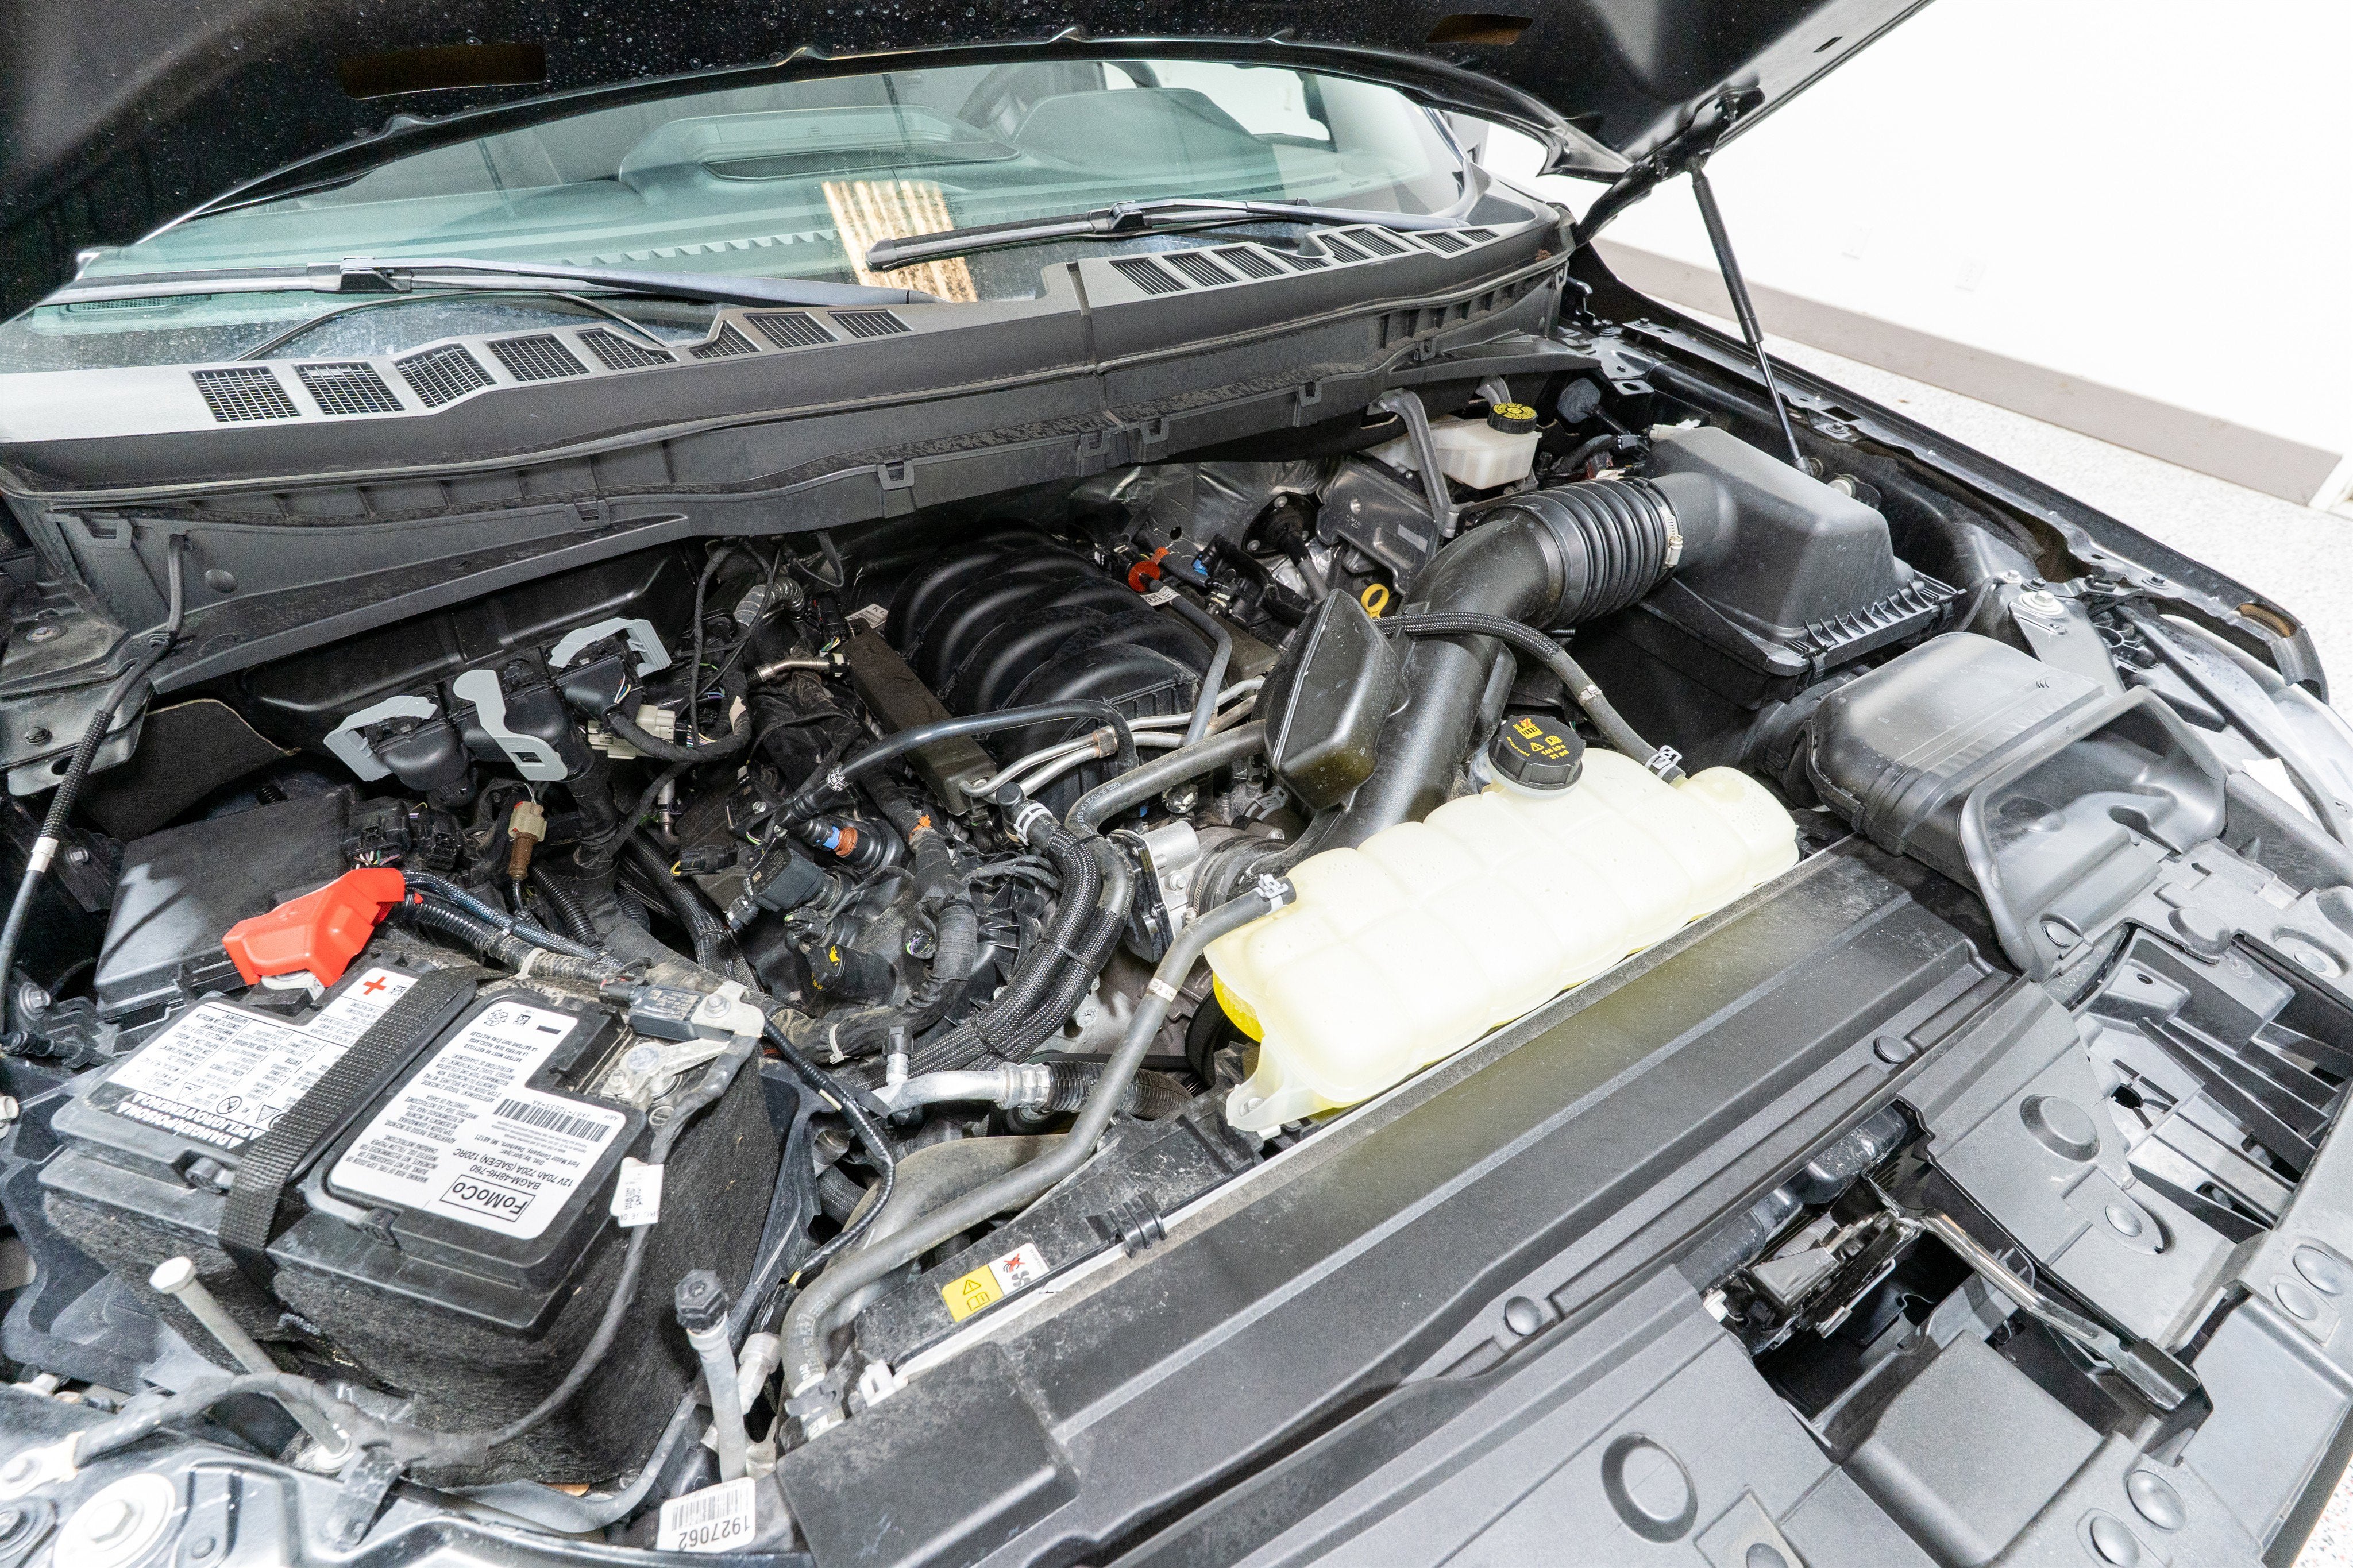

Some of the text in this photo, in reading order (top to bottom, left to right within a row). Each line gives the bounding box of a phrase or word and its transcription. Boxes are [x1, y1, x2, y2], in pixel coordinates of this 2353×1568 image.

[127, 1104, 232, 1145] DANGER/POISON
[144, 1094, 256, 1137] PELIGRO/VENENO
[533, 1100, 591, 1118] JX6T-10655-AA
[501, 1141, 526, 1152] Dearborn,
[453, 1148, 573, 1187] 12V 70Ah 720A (SAE/EN) 120RC
[470, 1165, 541, 1190] BAGM-48H6-760
[453, 1182, 528, 1215] FoMoCo
[678, 1515, 751, 1550] 1927062
